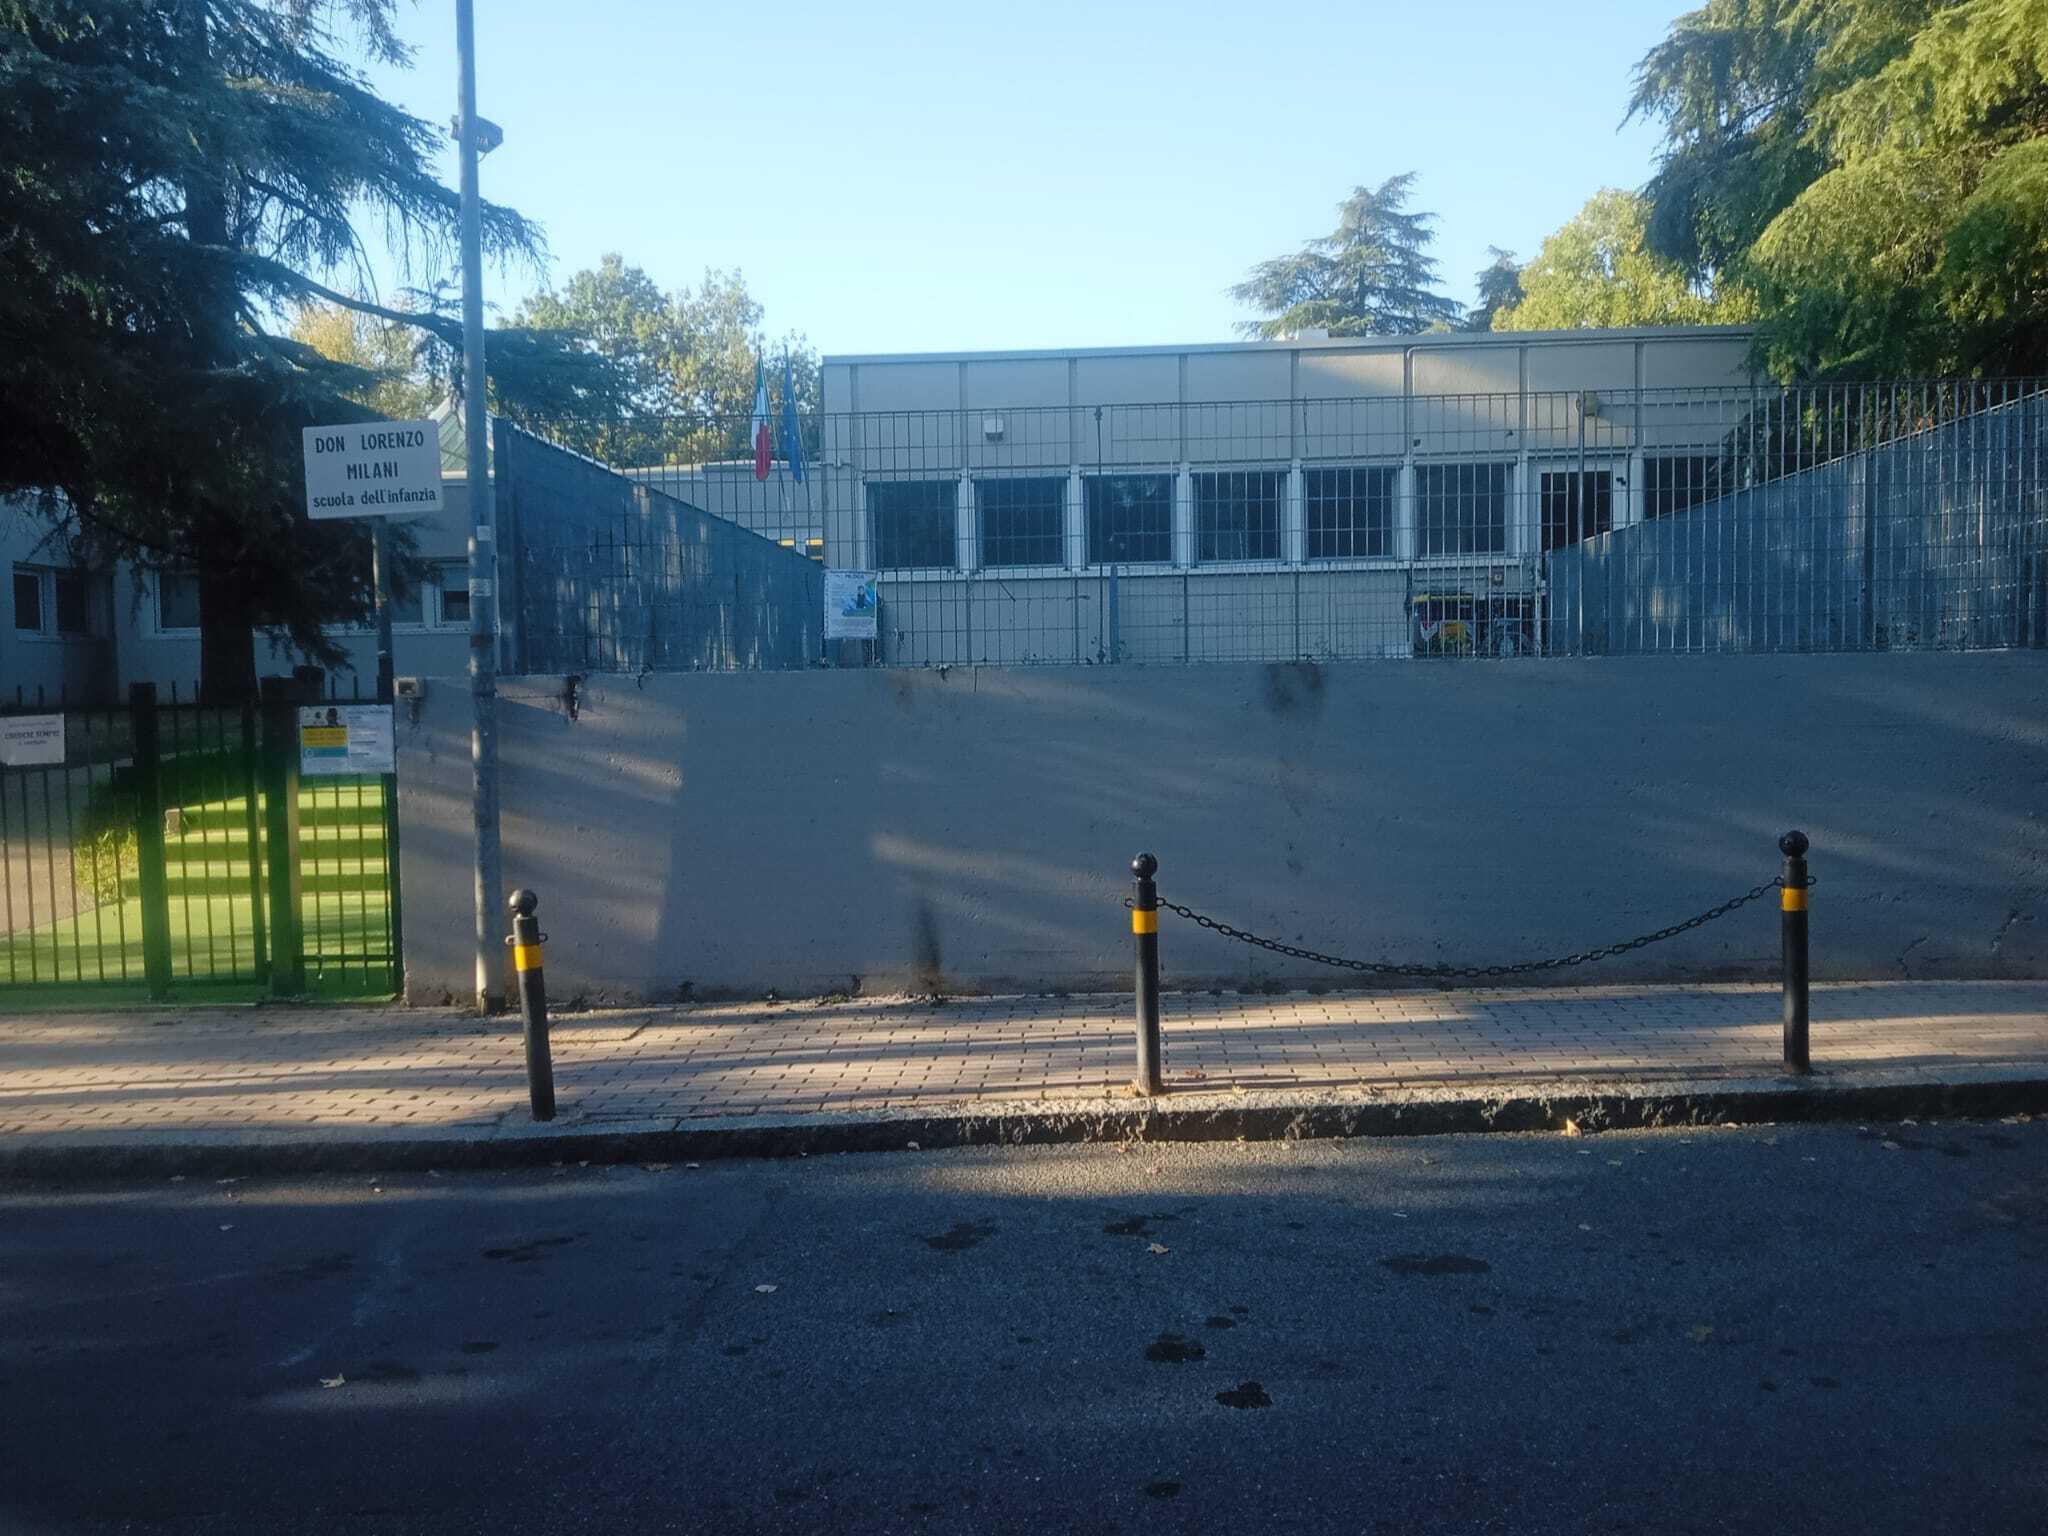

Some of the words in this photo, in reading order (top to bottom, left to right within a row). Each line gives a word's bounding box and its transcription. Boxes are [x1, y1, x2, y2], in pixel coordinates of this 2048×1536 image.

[316, 436, 345, 453] DON
[361, 430, 424, 450] LORENZO
[347, 462, 398, 480] MILANI
[313, 492, 354, 507] scuola
[361, 488, 436, 505] dell'infanzia
